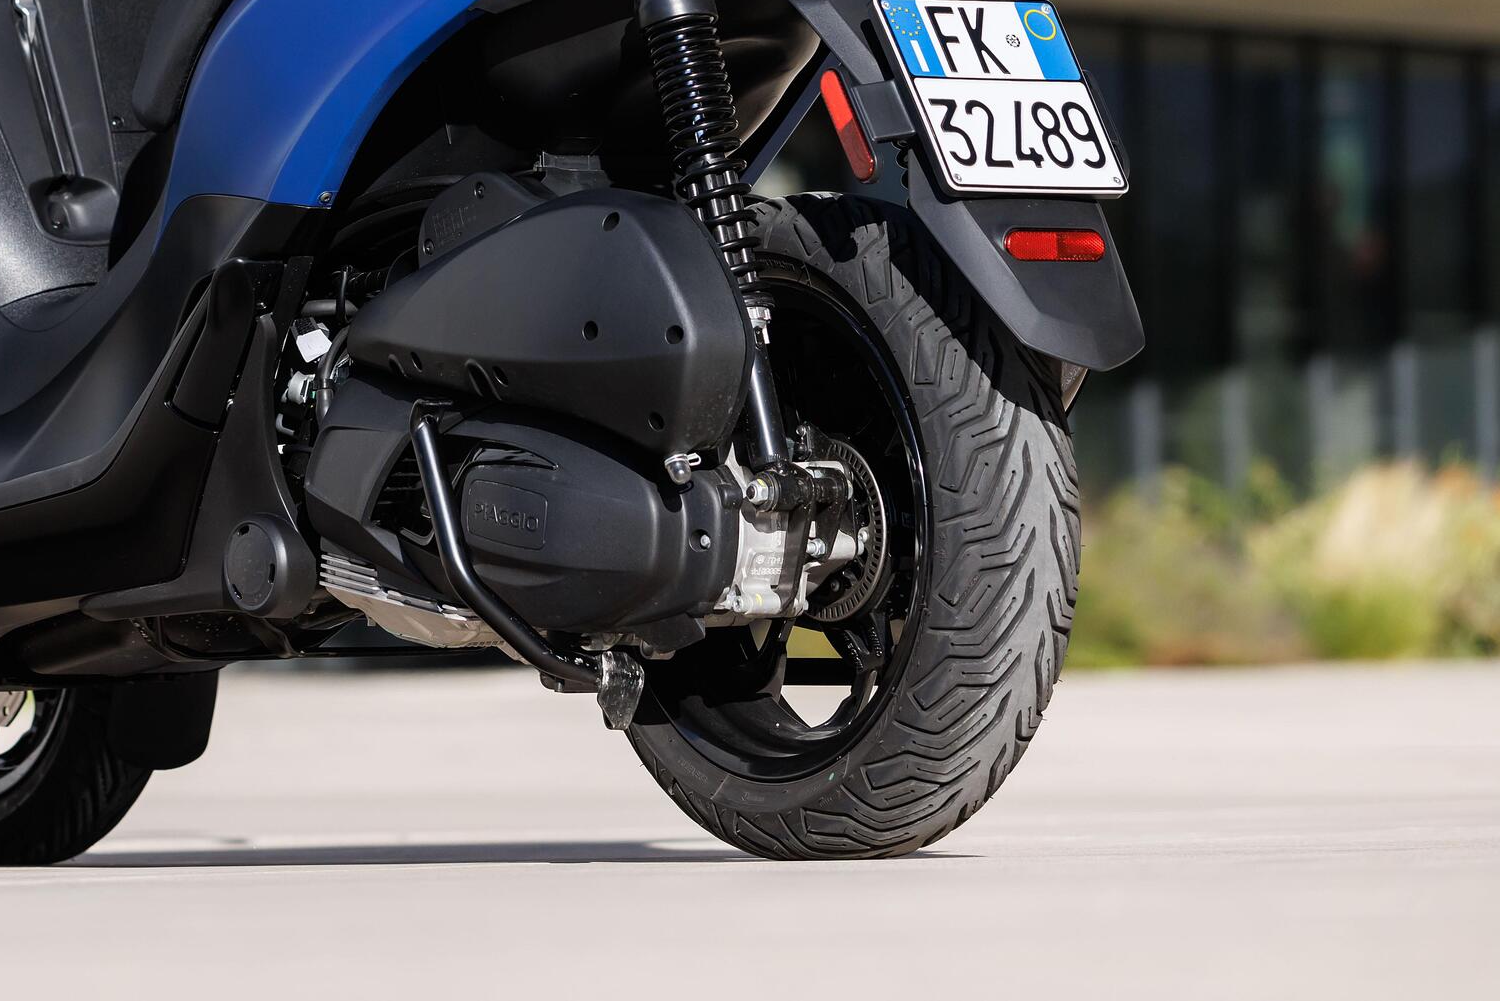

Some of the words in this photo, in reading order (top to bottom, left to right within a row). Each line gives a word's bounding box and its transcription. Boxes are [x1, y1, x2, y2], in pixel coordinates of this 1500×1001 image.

[924, 6, 1011, 74] FK
[928, 98, 1106, 169] 32489
[474, 502, 539, 532] PIAGGIO
